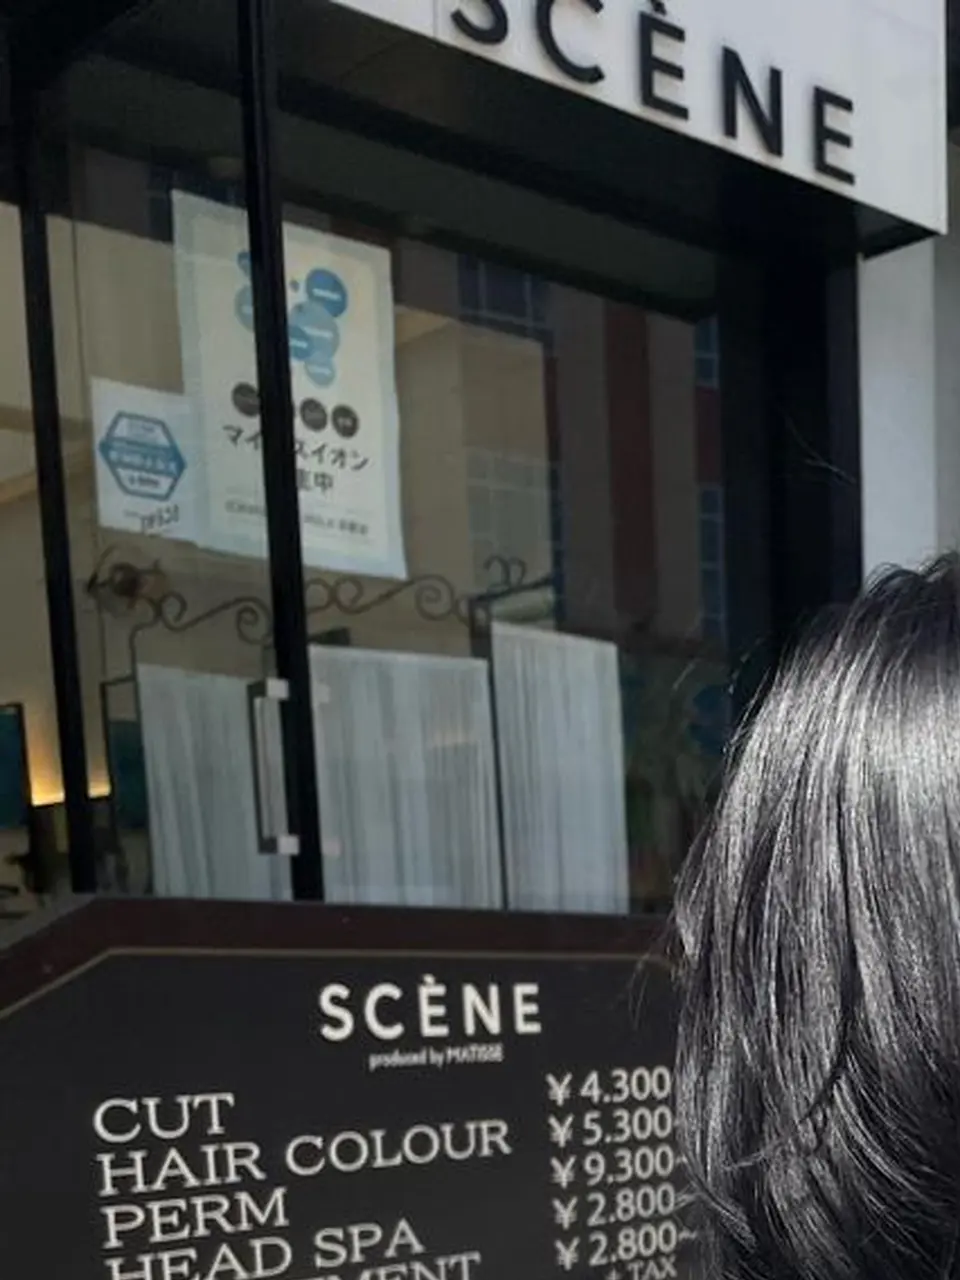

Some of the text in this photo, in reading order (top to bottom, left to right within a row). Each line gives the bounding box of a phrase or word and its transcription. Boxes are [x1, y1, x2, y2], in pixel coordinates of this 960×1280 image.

[222, 424, 370, 471] マイスイオン
[319, 973, 542, 1042] SCÈNE
[368, 1048, 427, 1072] produced
[429, 1046, 444, 1067] by
[93, 1092, 236, 1143] CUT
[96, 1118, 513, 1197] HAIR COLOUR
[100, 1186, 290, 1249] PERM
[314, 1217, 426, 1269] SPA
